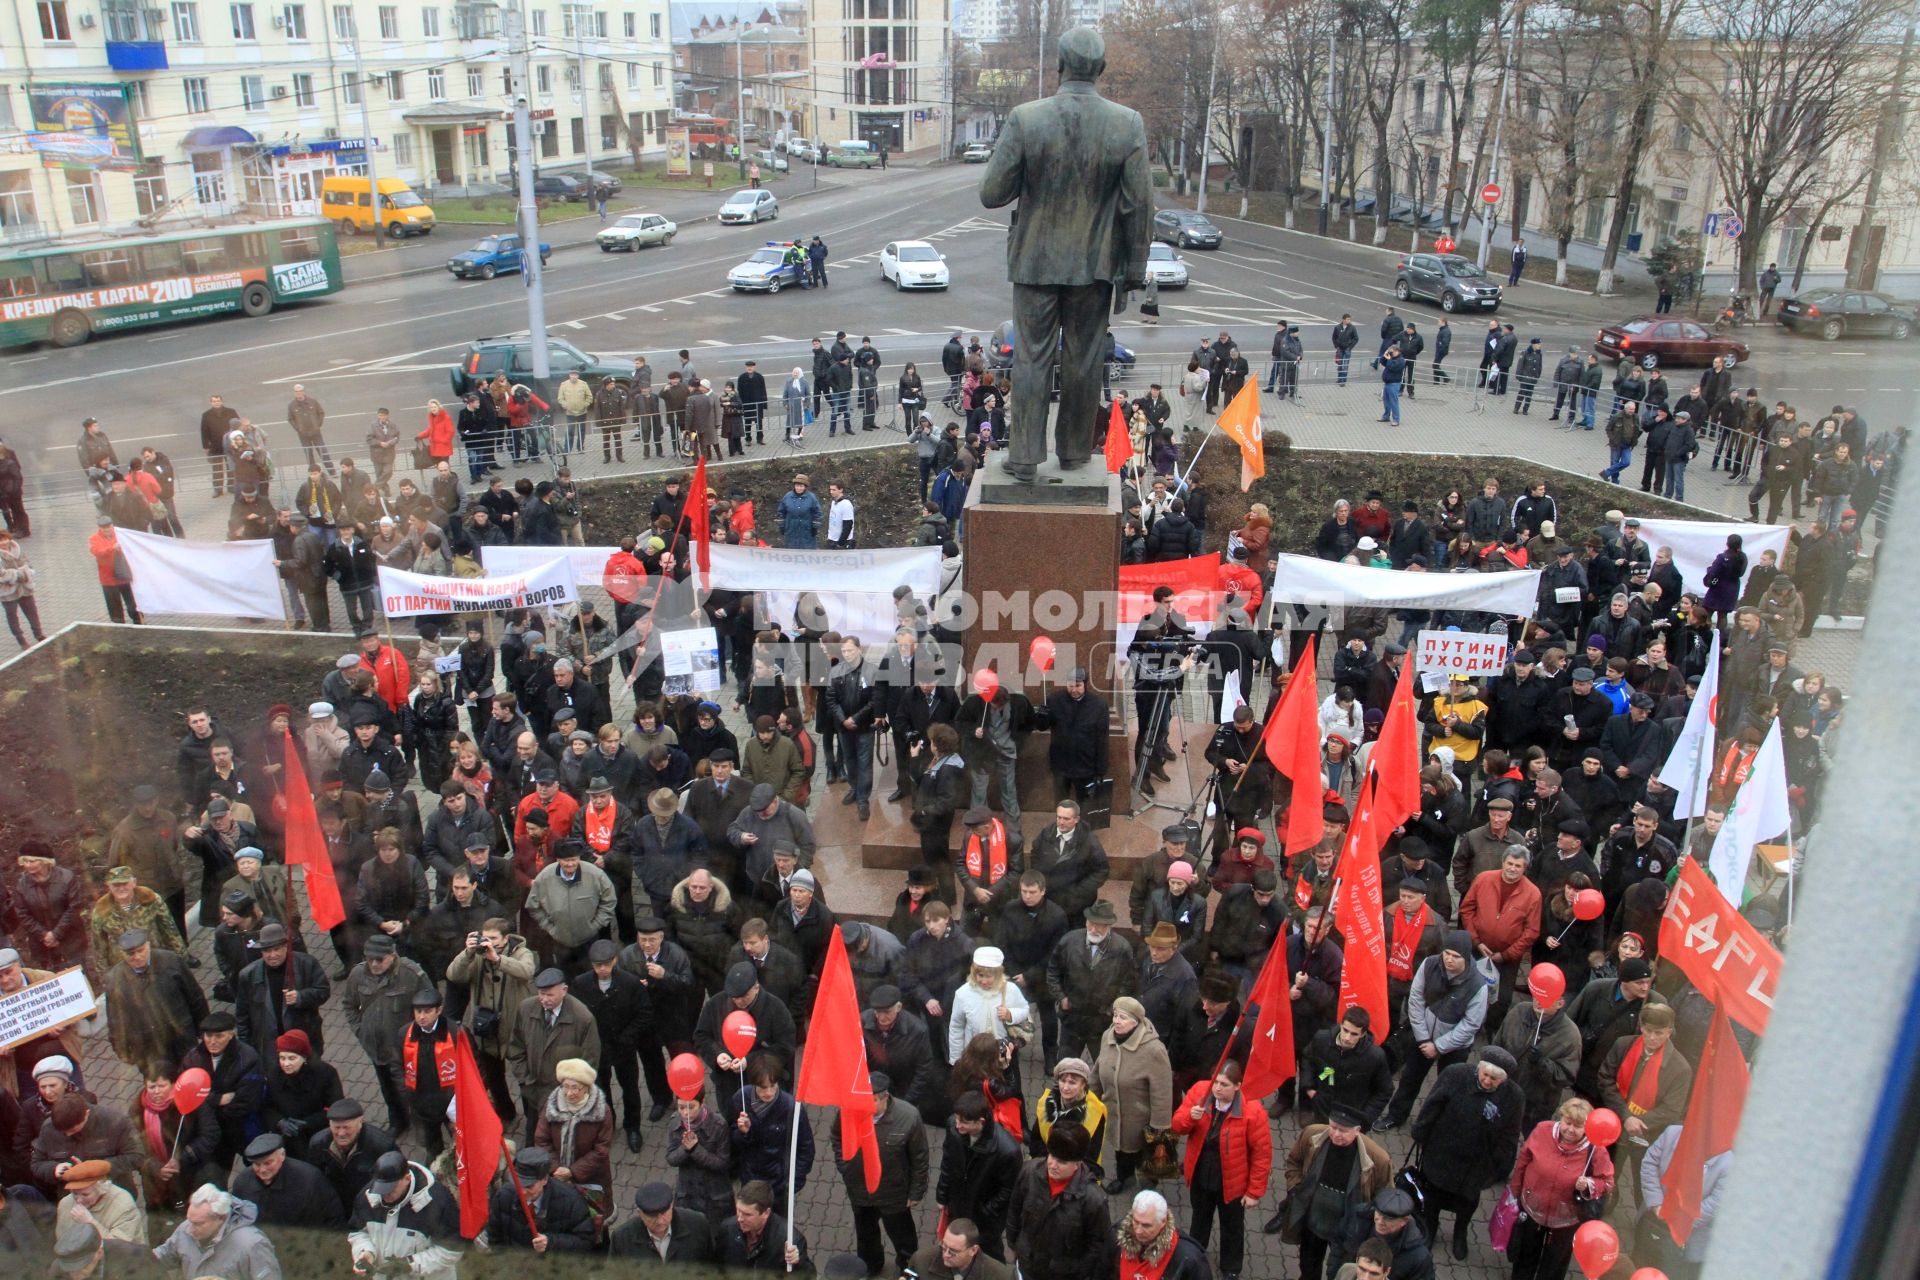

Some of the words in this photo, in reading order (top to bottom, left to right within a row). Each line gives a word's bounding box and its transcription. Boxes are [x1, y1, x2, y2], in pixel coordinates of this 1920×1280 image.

[340, 138, 376, 149] АПТЕА
[288, 262, 325, 283] БАНК
[194, 278, 243, 292] БЕСПЛАТНО
[290, 274, 328, 290] АВАНГАРД
[3, 292, 96, 319] КРЕДИТНЫЕ
[98, 284, 149, 306] КАРТЫ
[150, 277, 193, 304] 200
[171, 301, 235, 316] www.avangard.ru
[422, 581, 484, 598] ЗАЩИТИМ
[486, 578, 528, 596] НАРОД
[386, 596, 402, 612] ОТ
[404, 595, 451, 611] ПАРТИИ
[453, 597, 513, 611] ЖУЛИКОВ
[515, 595, 524, 608] И
[525, 584, 566, 606] ВОРОВ
[1425, 639, 1495, 655] ПУТИН
[1388, 957, 1410, 970] КПРФ
[21, 979, 61, 1001] ОГРОМНАЯ
[6, 993, 49, 1017] СМЕРТНЫЙ
[49, 988, 65, 1000] БОЙ
